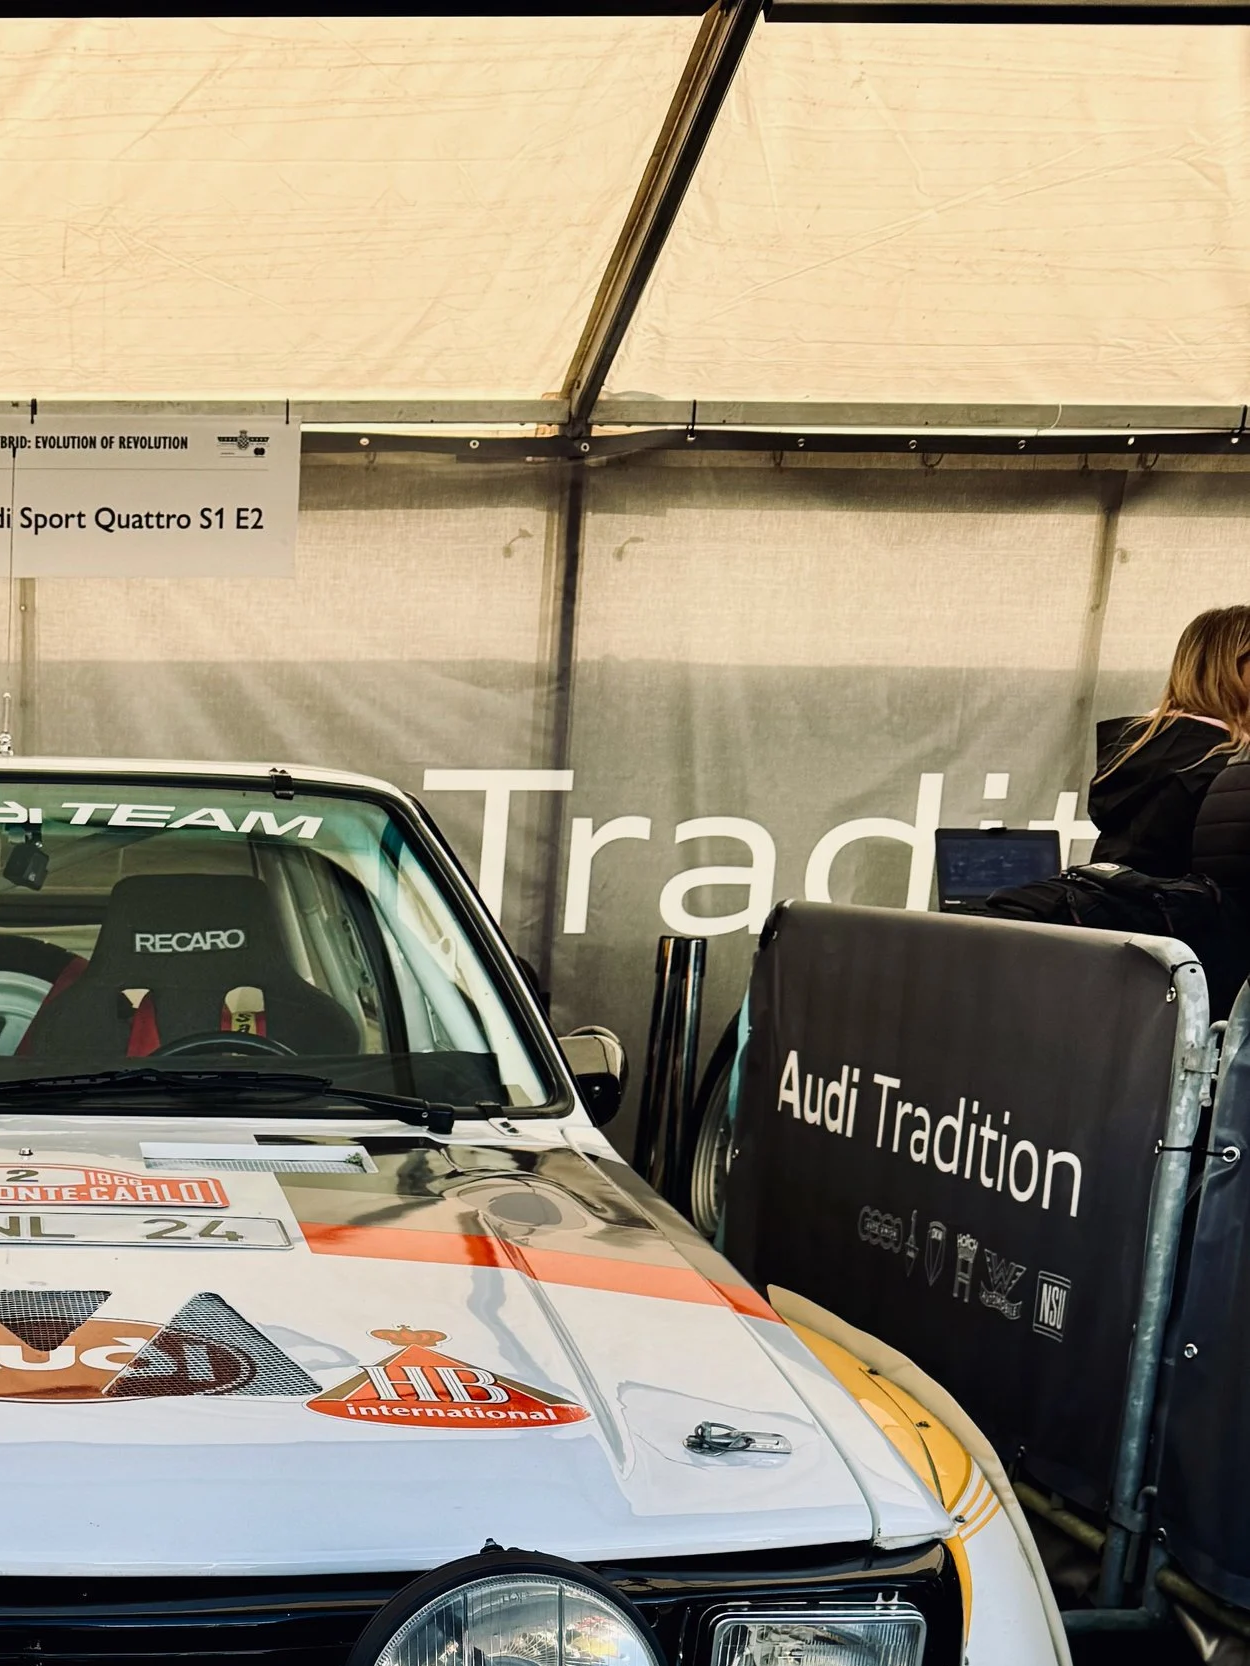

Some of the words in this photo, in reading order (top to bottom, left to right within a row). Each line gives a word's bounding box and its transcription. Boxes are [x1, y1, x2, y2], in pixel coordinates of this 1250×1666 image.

[35, 435, 97, 449] EVOLUTION
[100, 436, 115, 450] OF
[118, 436, 188, 450] REVOLUTION
[19, 506, 87, 536] Sport
[94, 507, 192, 534] Quattro
[199, 507, 224, 530] S1
[236, 507, 264, 530] E2
[61, 802, 324, 839] TEAM
[134, 929, 246, 953] RECARO
[777, 1050, 861, 1139] Audi
[873, 1073, 1082, 1218] Tradition
[5, 1169, 40, 1183] 2
[88, 1170, 143, 1186] 1986
[143, 1217, 245, 1242] 24
[1039, 1283, 1068, 1331] NSU
[359, 1365, 511, 1405] HB
[346, 1403, 559, 1422] international
